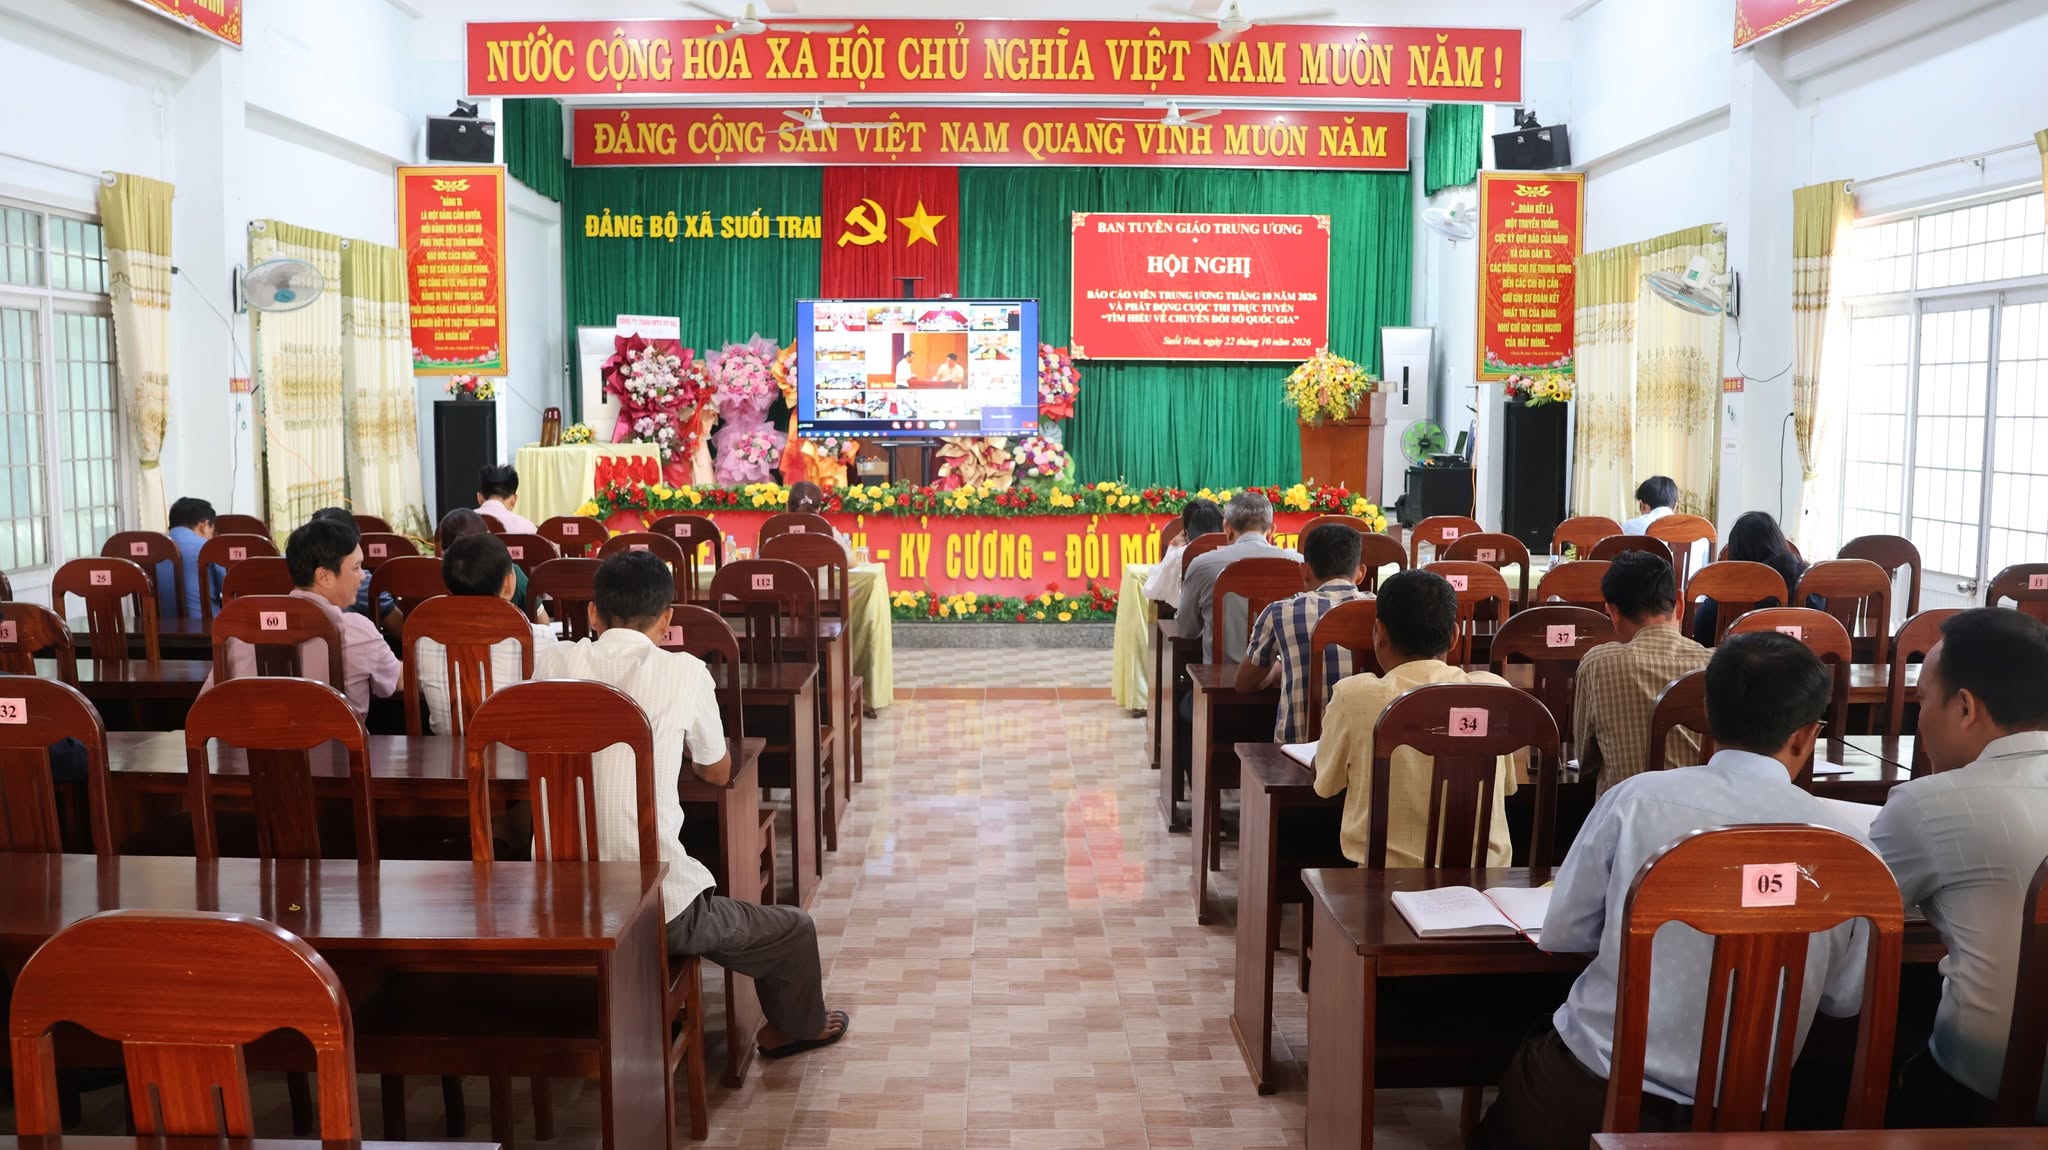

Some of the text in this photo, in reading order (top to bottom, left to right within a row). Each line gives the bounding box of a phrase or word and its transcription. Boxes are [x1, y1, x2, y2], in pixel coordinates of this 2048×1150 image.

[486, 25, 575, 82] NƯỚC
[586, 25, 674, 92] CỘNG
[681, 24, 752, 79] HÒA
[826, 24, 885, 90] HỘI
[898, 22, 970, 80] CHỦ
[982, 26, 1094, 80] NGHĨA
[1106, 27, 1190, 91] VIỆT
[1206, 40, 1286, 83] NAM
[1300, 30, 1394, 87] MUÔN
[1407, 33, 1484, 87] NĂM
[595, 109, 1387, 162] ĐẢNG CỘNG SẢN VIỆT NAM QUANG VINH MUÔN NĂM
[585, 208, 821, 242] ĐẢNG BỘ XÃ SUỐI TRAI
[1098, 219, 1302, 234] BAN TUYÊN GIÁO TRUNG ƯƠNG
[1147, 254, 1251, 278] HỘI NGHỊ
[1087, 289, 1108, 299] BÁO
[1109, 289, 1131, 299] CÁO
[1133, 289, 1156, 299] VIÊN
[1158, 291, 1193, 300] TRUNG
[1194, 291, 1224, 300] ƯƠNG
[1226, 290, 1260, 300] THÁNG
[1262, 292, 1272, 300] 10
[1273, 291, 1296, 301] NĂM
[1109, 301, 1294, 314] VÀ PHÁT ĐỘNG CUỘC THI TRỰC TUYẾN
[1168, 313, 1210, 323] CHUYỂN
[1231, 313, 1244, 323] SỐ
[1245, 313, 1274, 324] QUỐC
[1163, 335, 1181, 345] Suối
[1224, 337, 1235, 345] 22
[1291, 338, 1311, 346] 2026
[900, 516, 931, 579] KỶ
[946, 529, 1033, 580] CƯƠNG
[1065, 515, 1110, 578] ĐỔI
[1120, 523, 1160, 574] MỚ
[96, 574, 106, 583] 25
[756, 578, 771, 588] 112
[1452, 580, 1463, 588] 76
[266, 615, 279, 626] 60
[1556, 632, 1570, 644] 37
[0, 705, 17, 718] 32
[1459, 717, 1477, 731] 34
[1757, 873, 1783, 893] 05
